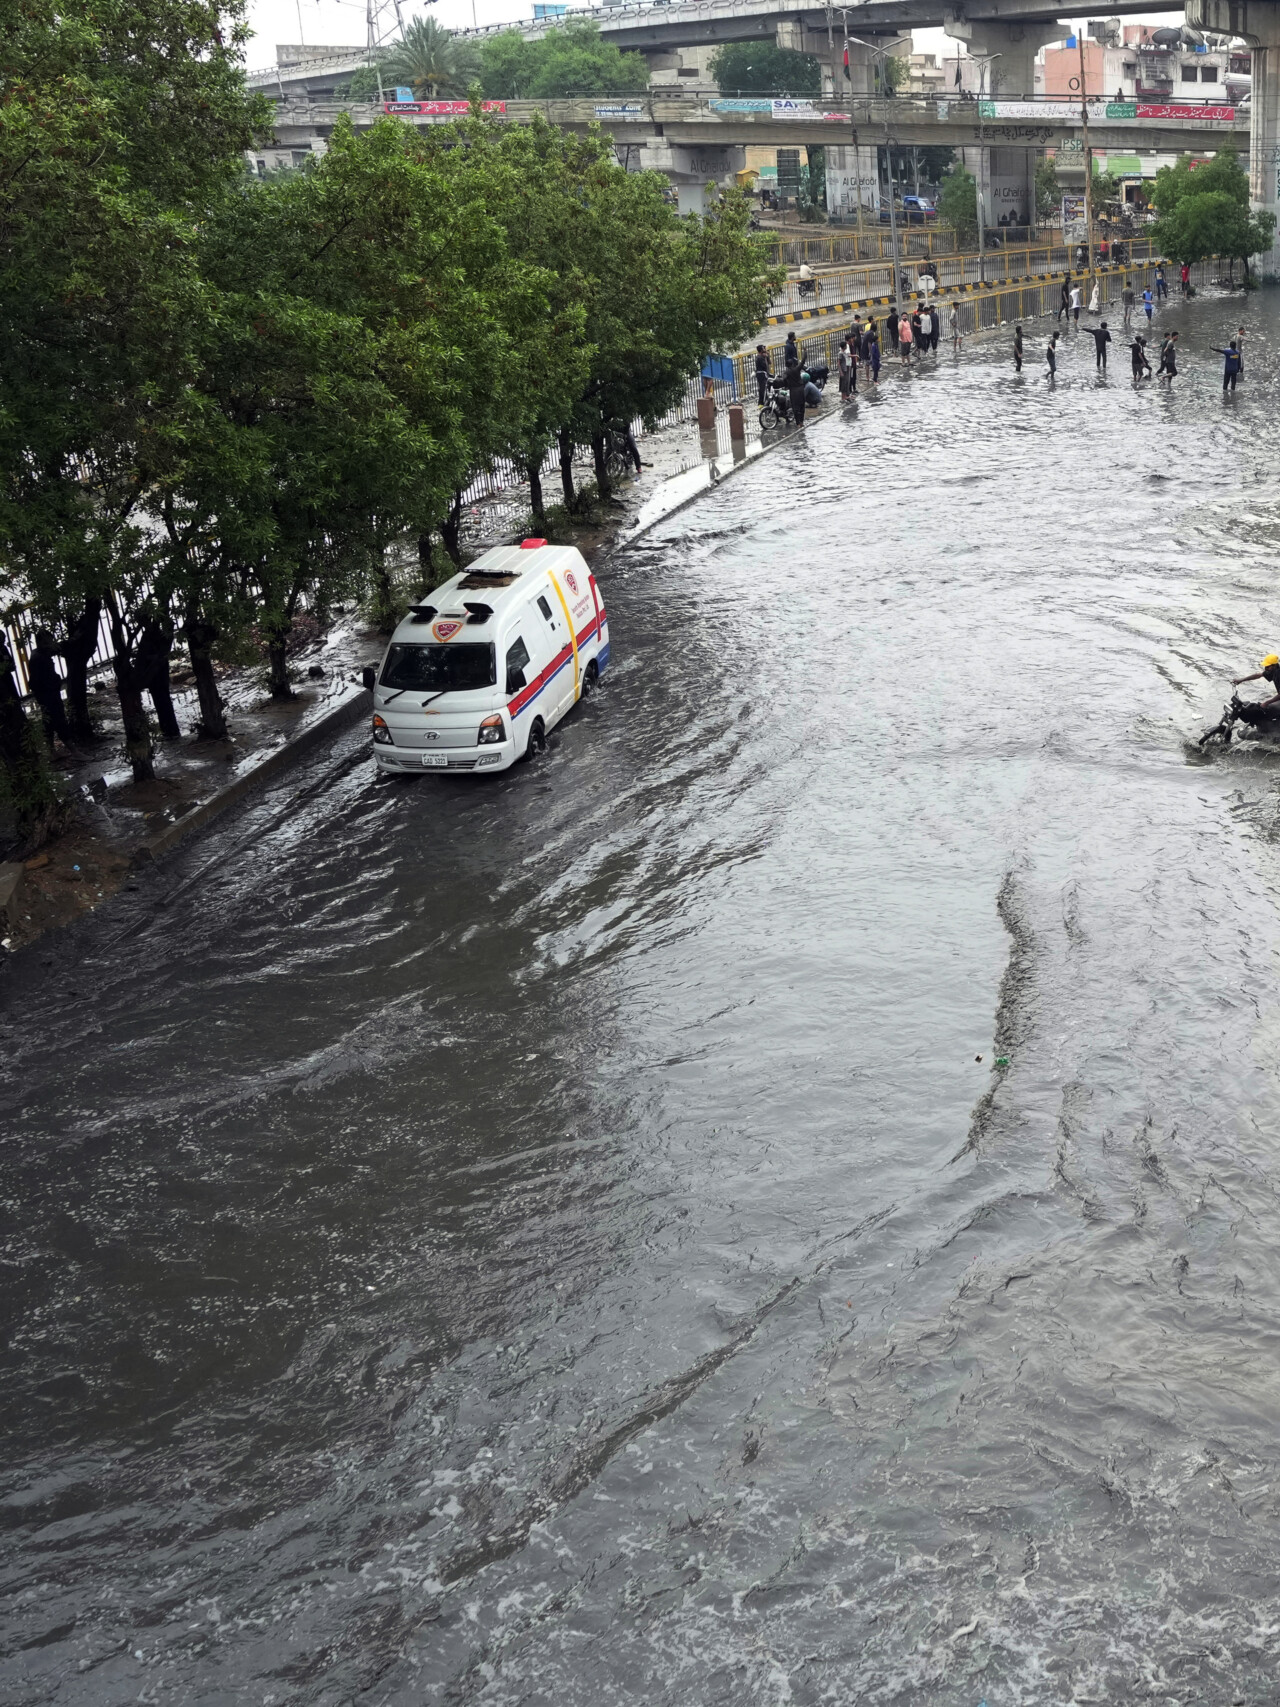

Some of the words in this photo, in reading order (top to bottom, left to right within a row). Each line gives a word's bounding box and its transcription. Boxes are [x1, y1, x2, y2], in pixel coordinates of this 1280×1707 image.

[1136, 104, 1153, 116] نامنظو
[1212, 107, 1232, 119] کراچی
[1063, 139, 1082, 150] PSP
[842, 177, 849, 186] Al
[993, 188, 1002, 198] Al
